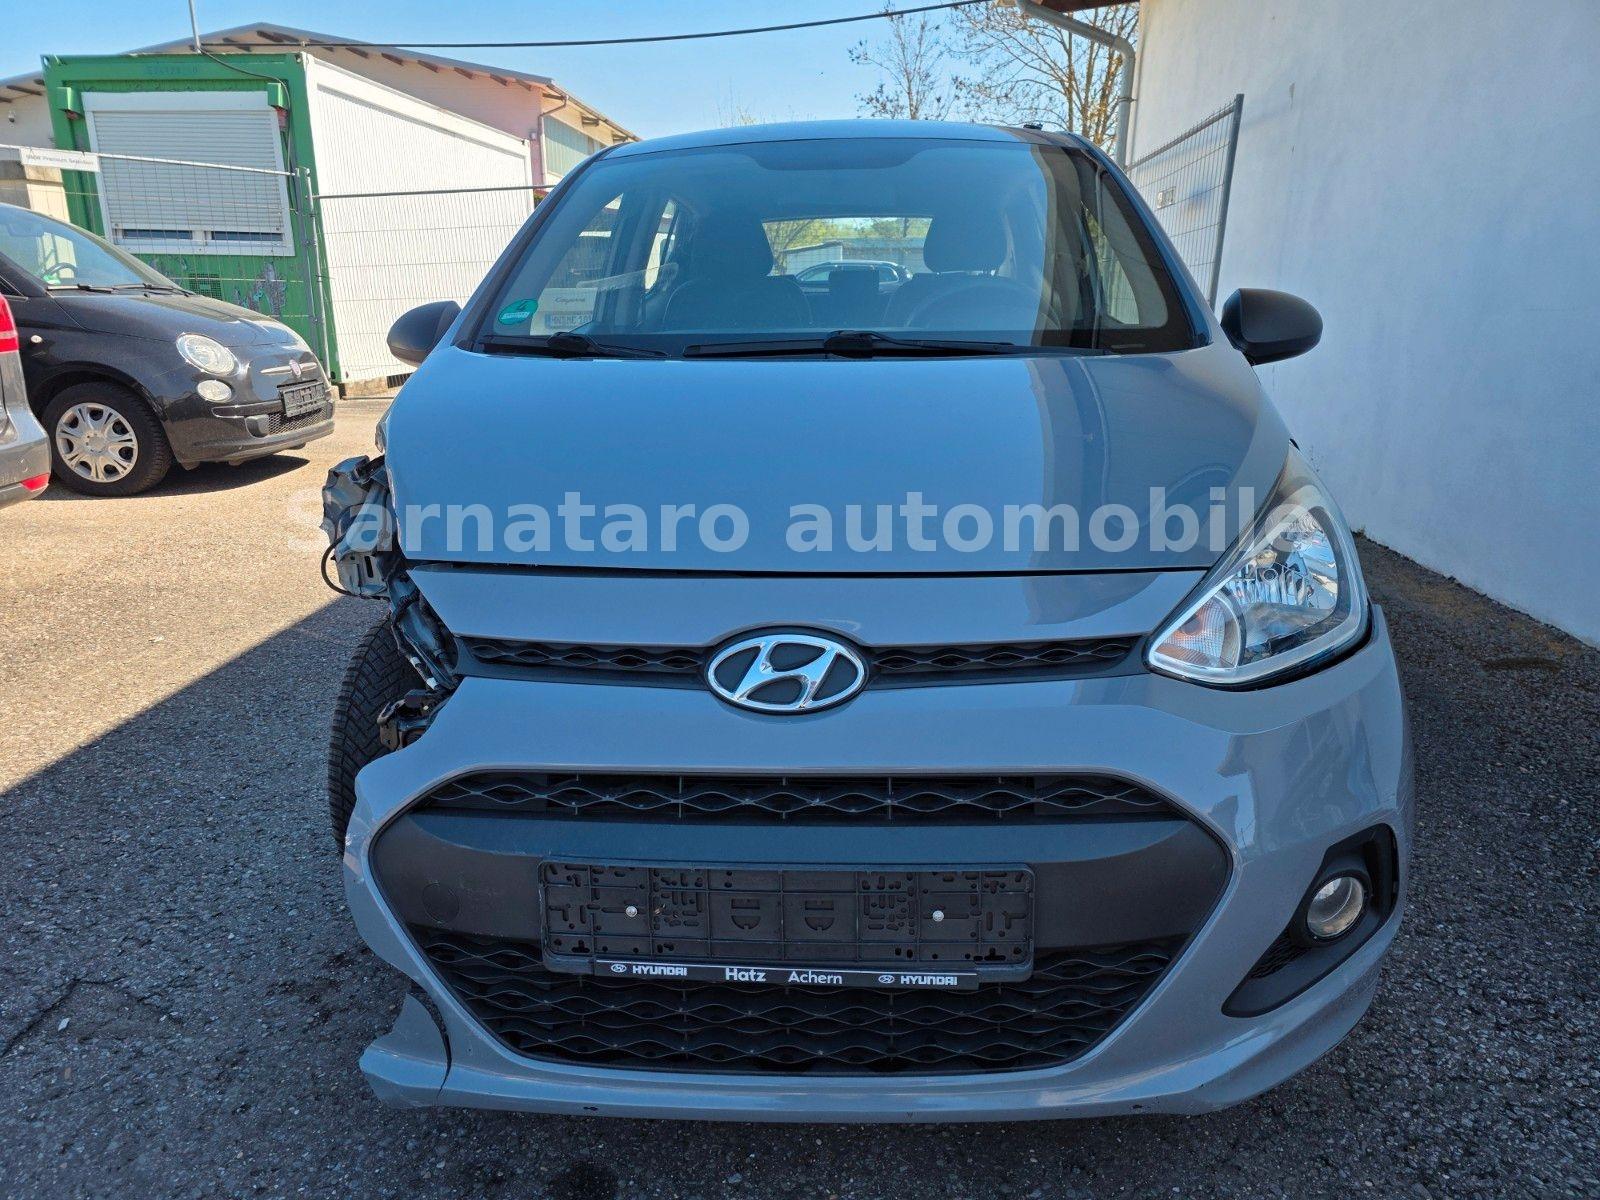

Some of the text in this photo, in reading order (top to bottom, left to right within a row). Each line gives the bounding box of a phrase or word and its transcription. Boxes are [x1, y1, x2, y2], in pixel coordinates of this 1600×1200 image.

[632, 965, 958, 986] HYUNDAI Hatz Achern HYUNDAI
